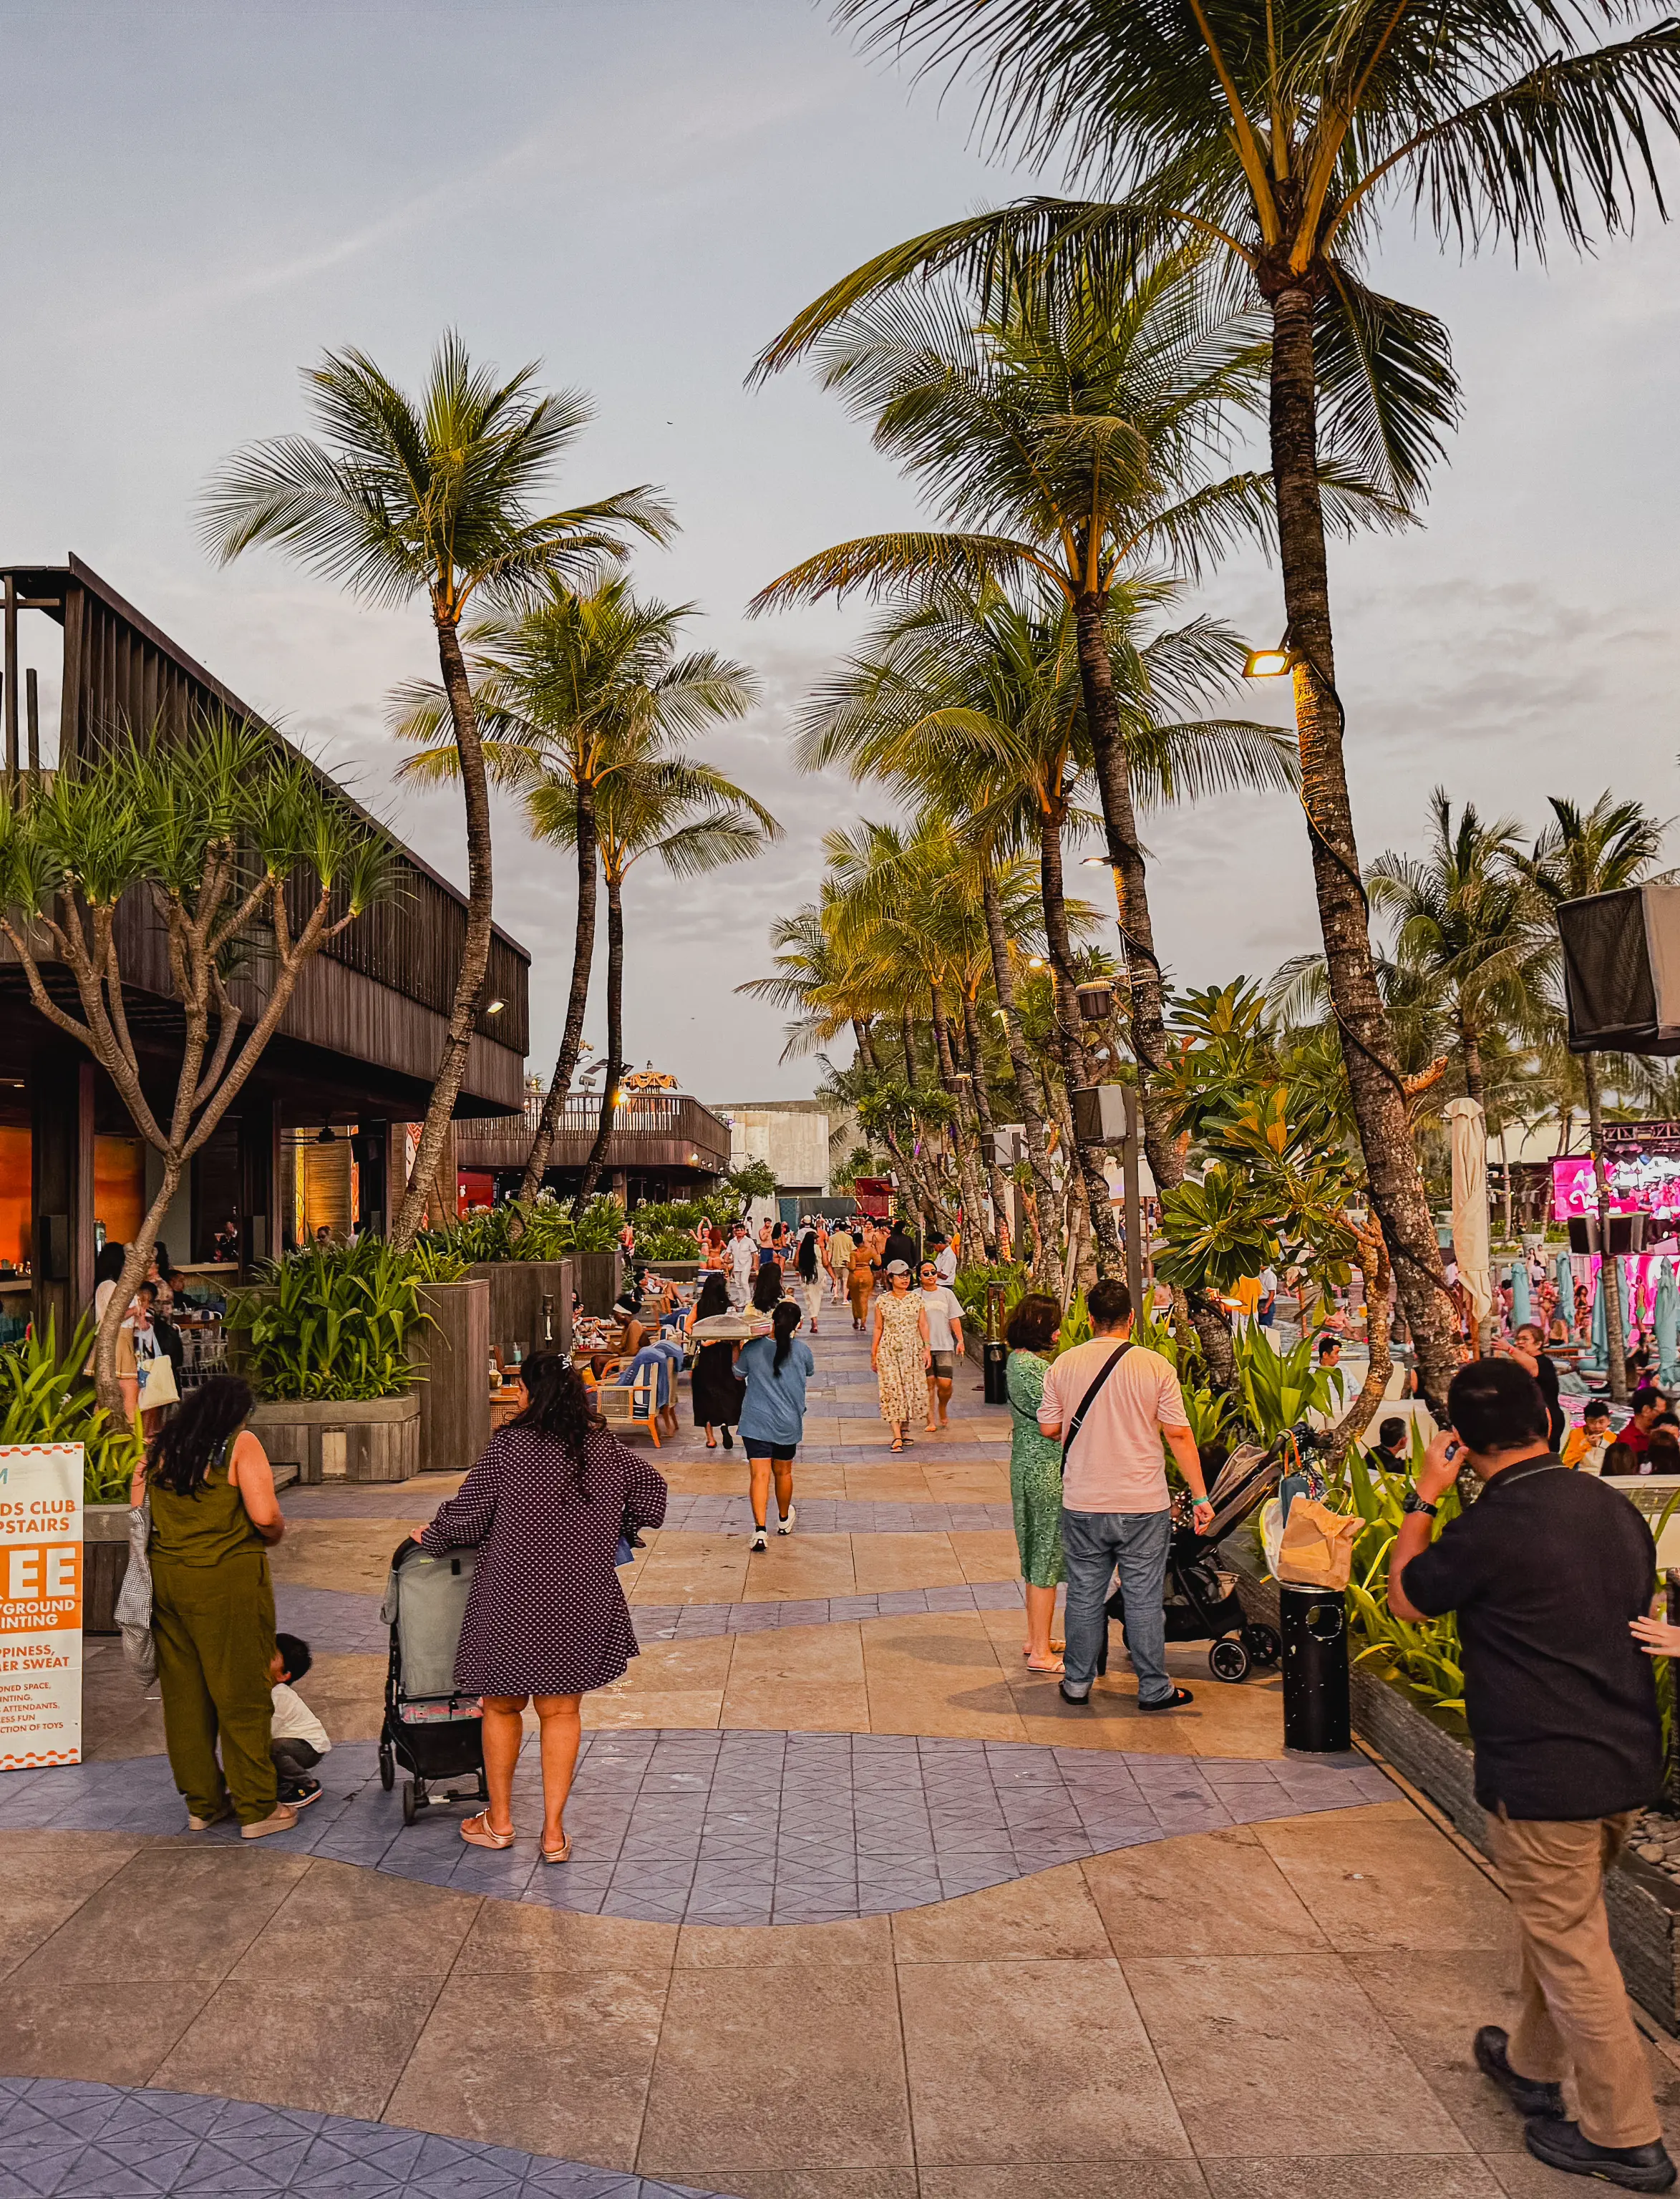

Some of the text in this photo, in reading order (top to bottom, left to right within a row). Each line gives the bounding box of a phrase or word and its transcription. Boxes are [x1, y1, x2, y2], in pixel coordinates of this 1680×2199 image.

[30, 1499, 76, 1515] CLUB
[0, 1547, 76, 1599] EE
[0, 1599, 75, 1616] GROUND
[0, 1644, 56, 1659] PINESS,
[0, 1656, 69, 1672] ER SWEAT
[24, 1682, 52, 1691] SPACE,
[3, 1702, 60, 1713] ATTENDANTS,
[42, 1722, 64, 1730] TOYS
